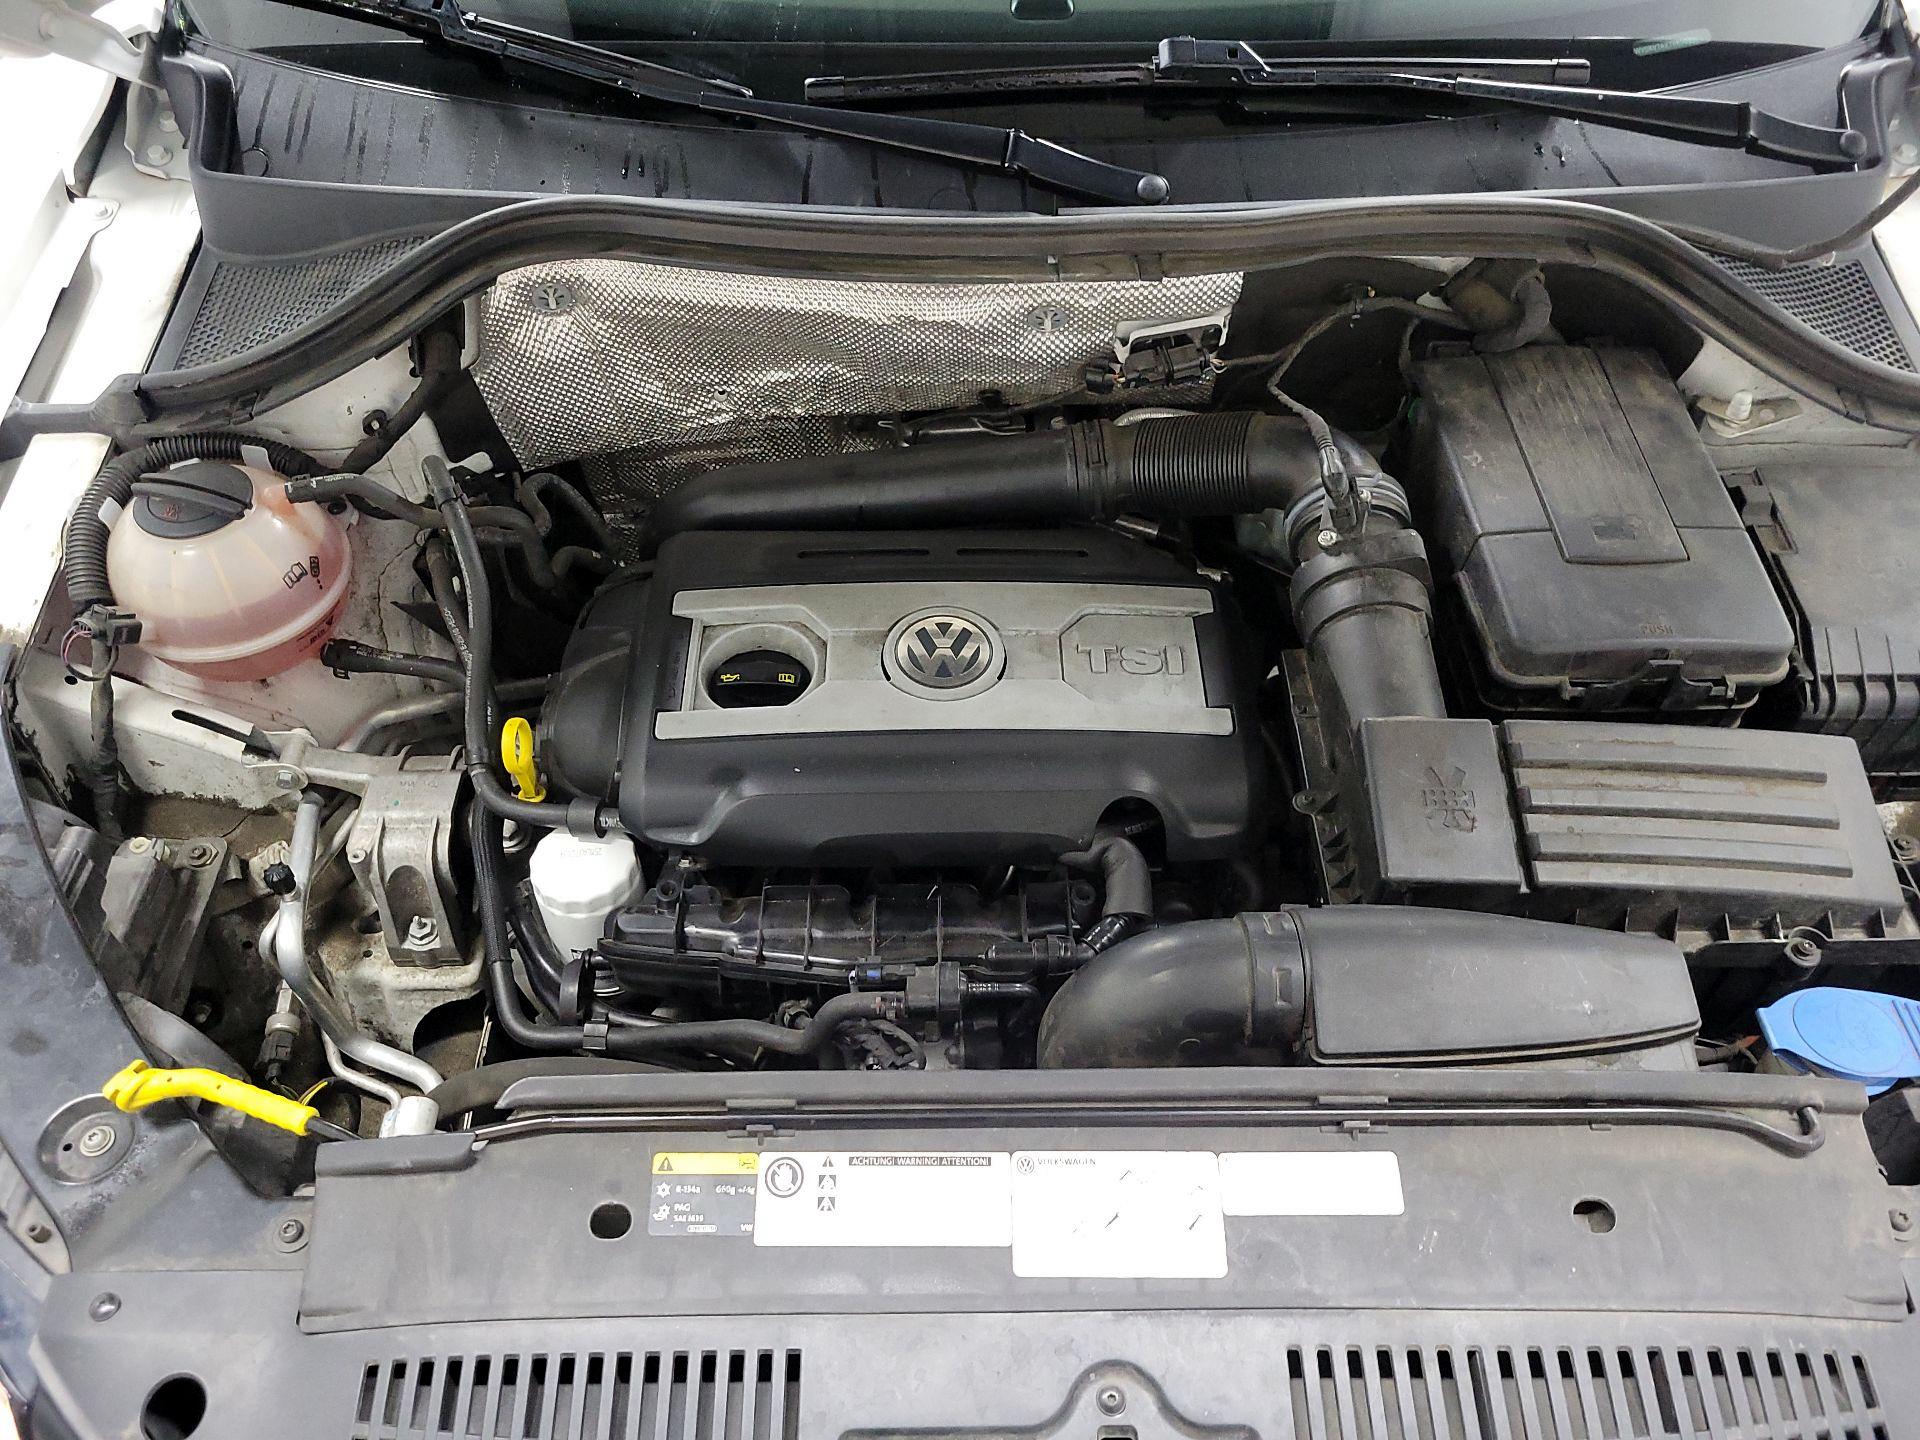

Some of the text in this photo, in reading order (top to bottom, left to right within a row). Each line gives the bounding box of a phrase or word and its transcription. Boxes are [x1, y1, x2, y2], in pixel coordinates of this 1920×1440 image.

[1077, 644, 1184, 675] TSI
[851, 1157, 989, 1166] ACHTUNG! WARNING! ATTENTION!
